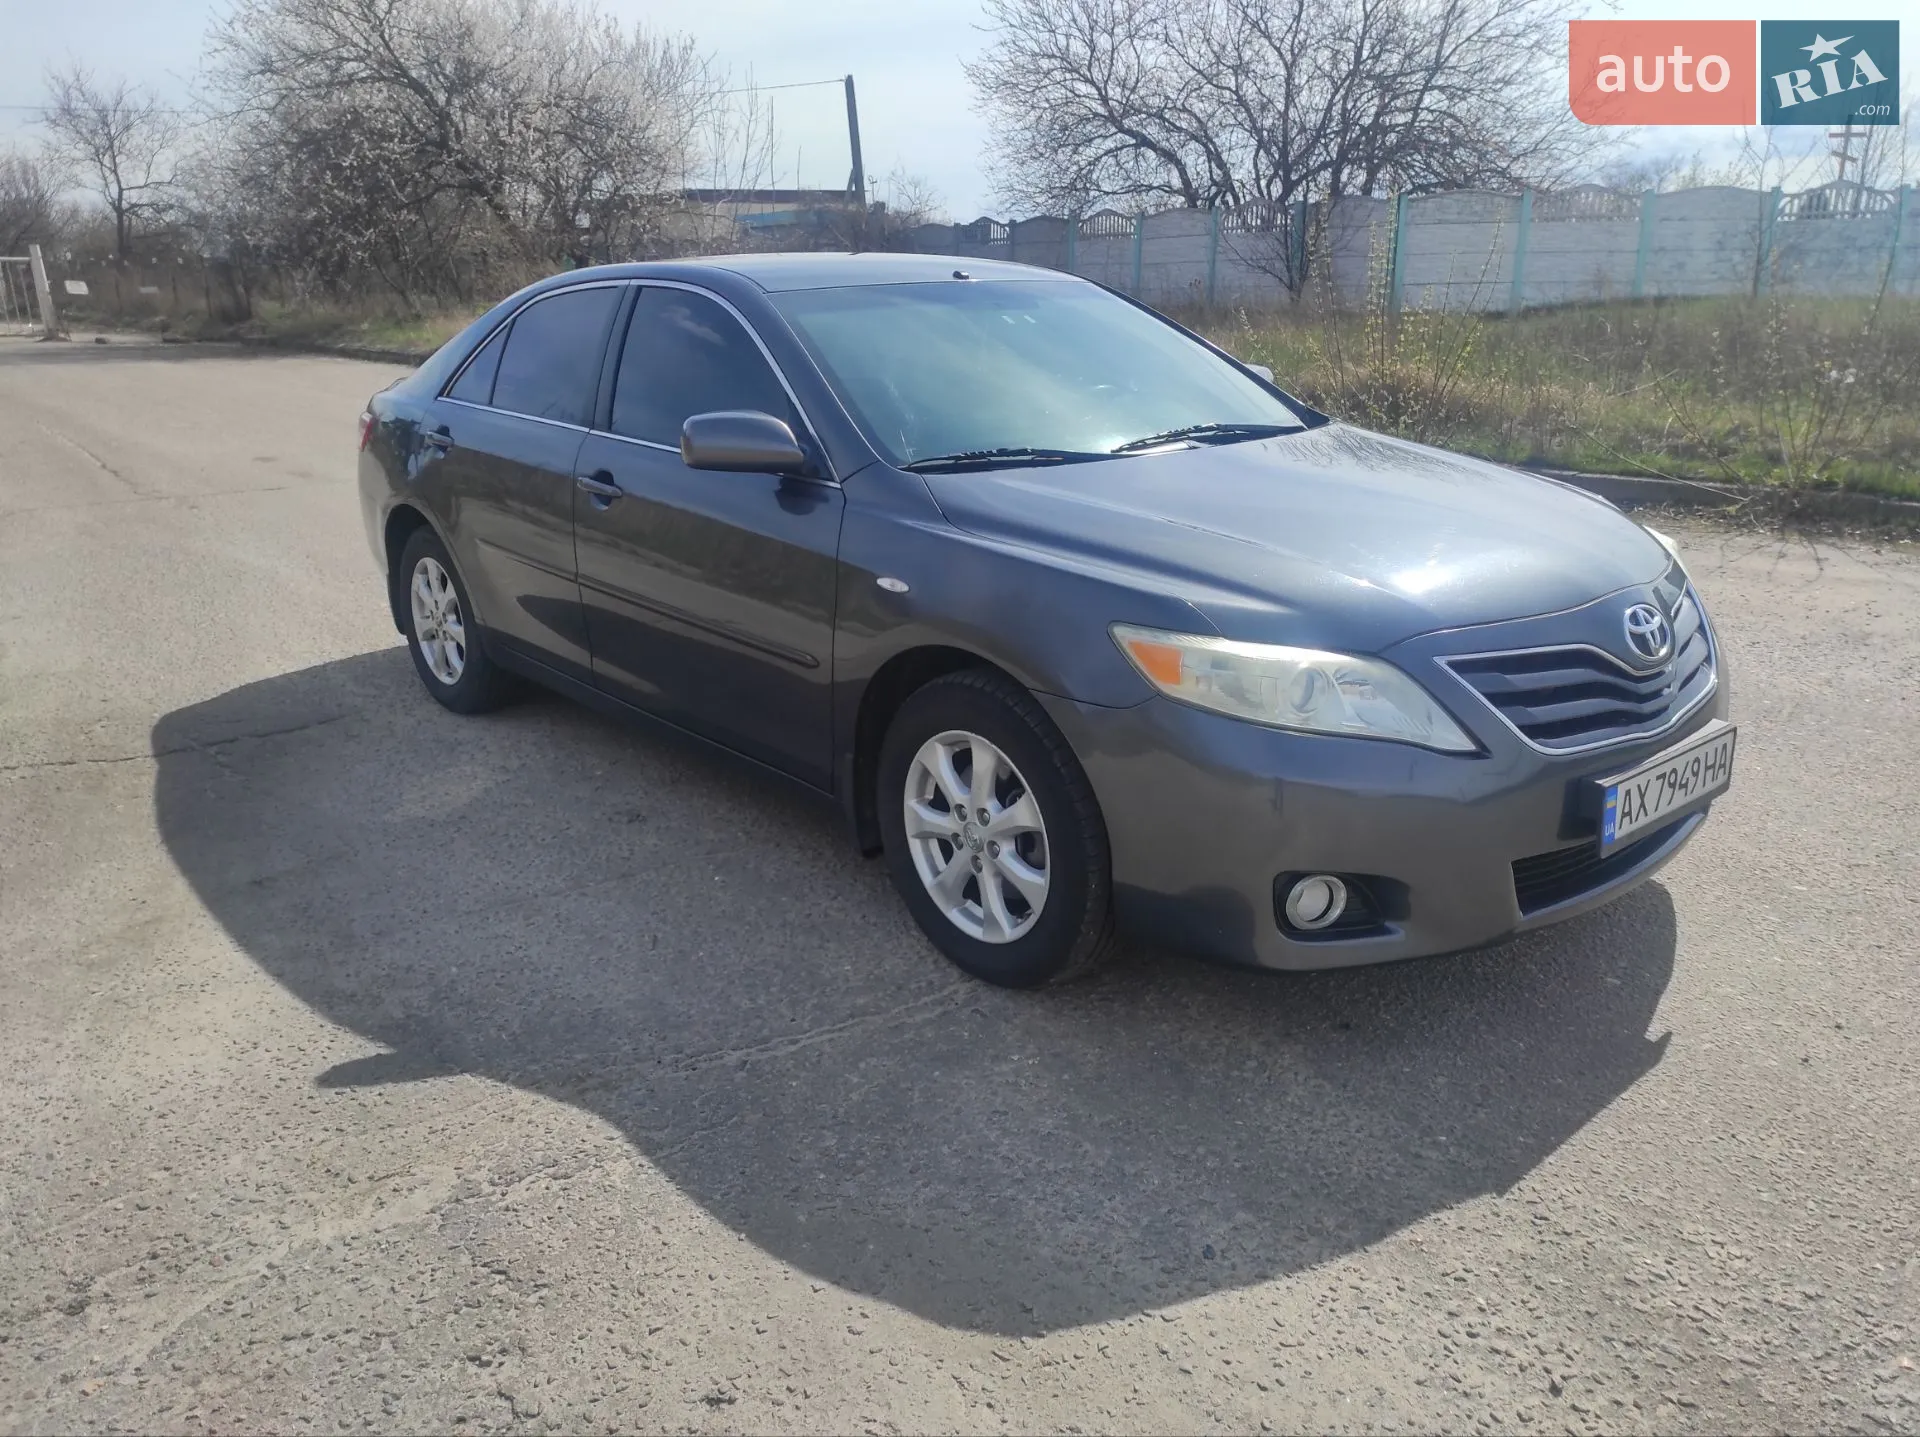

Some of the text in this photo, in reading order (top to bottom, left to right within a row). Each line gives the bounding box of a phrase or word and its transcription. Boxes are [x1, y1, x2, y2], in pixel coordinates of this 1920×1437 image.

[1618, 742, 1728, 830] AX 7949 HA
[1604, 823, 1615, 836] UA
